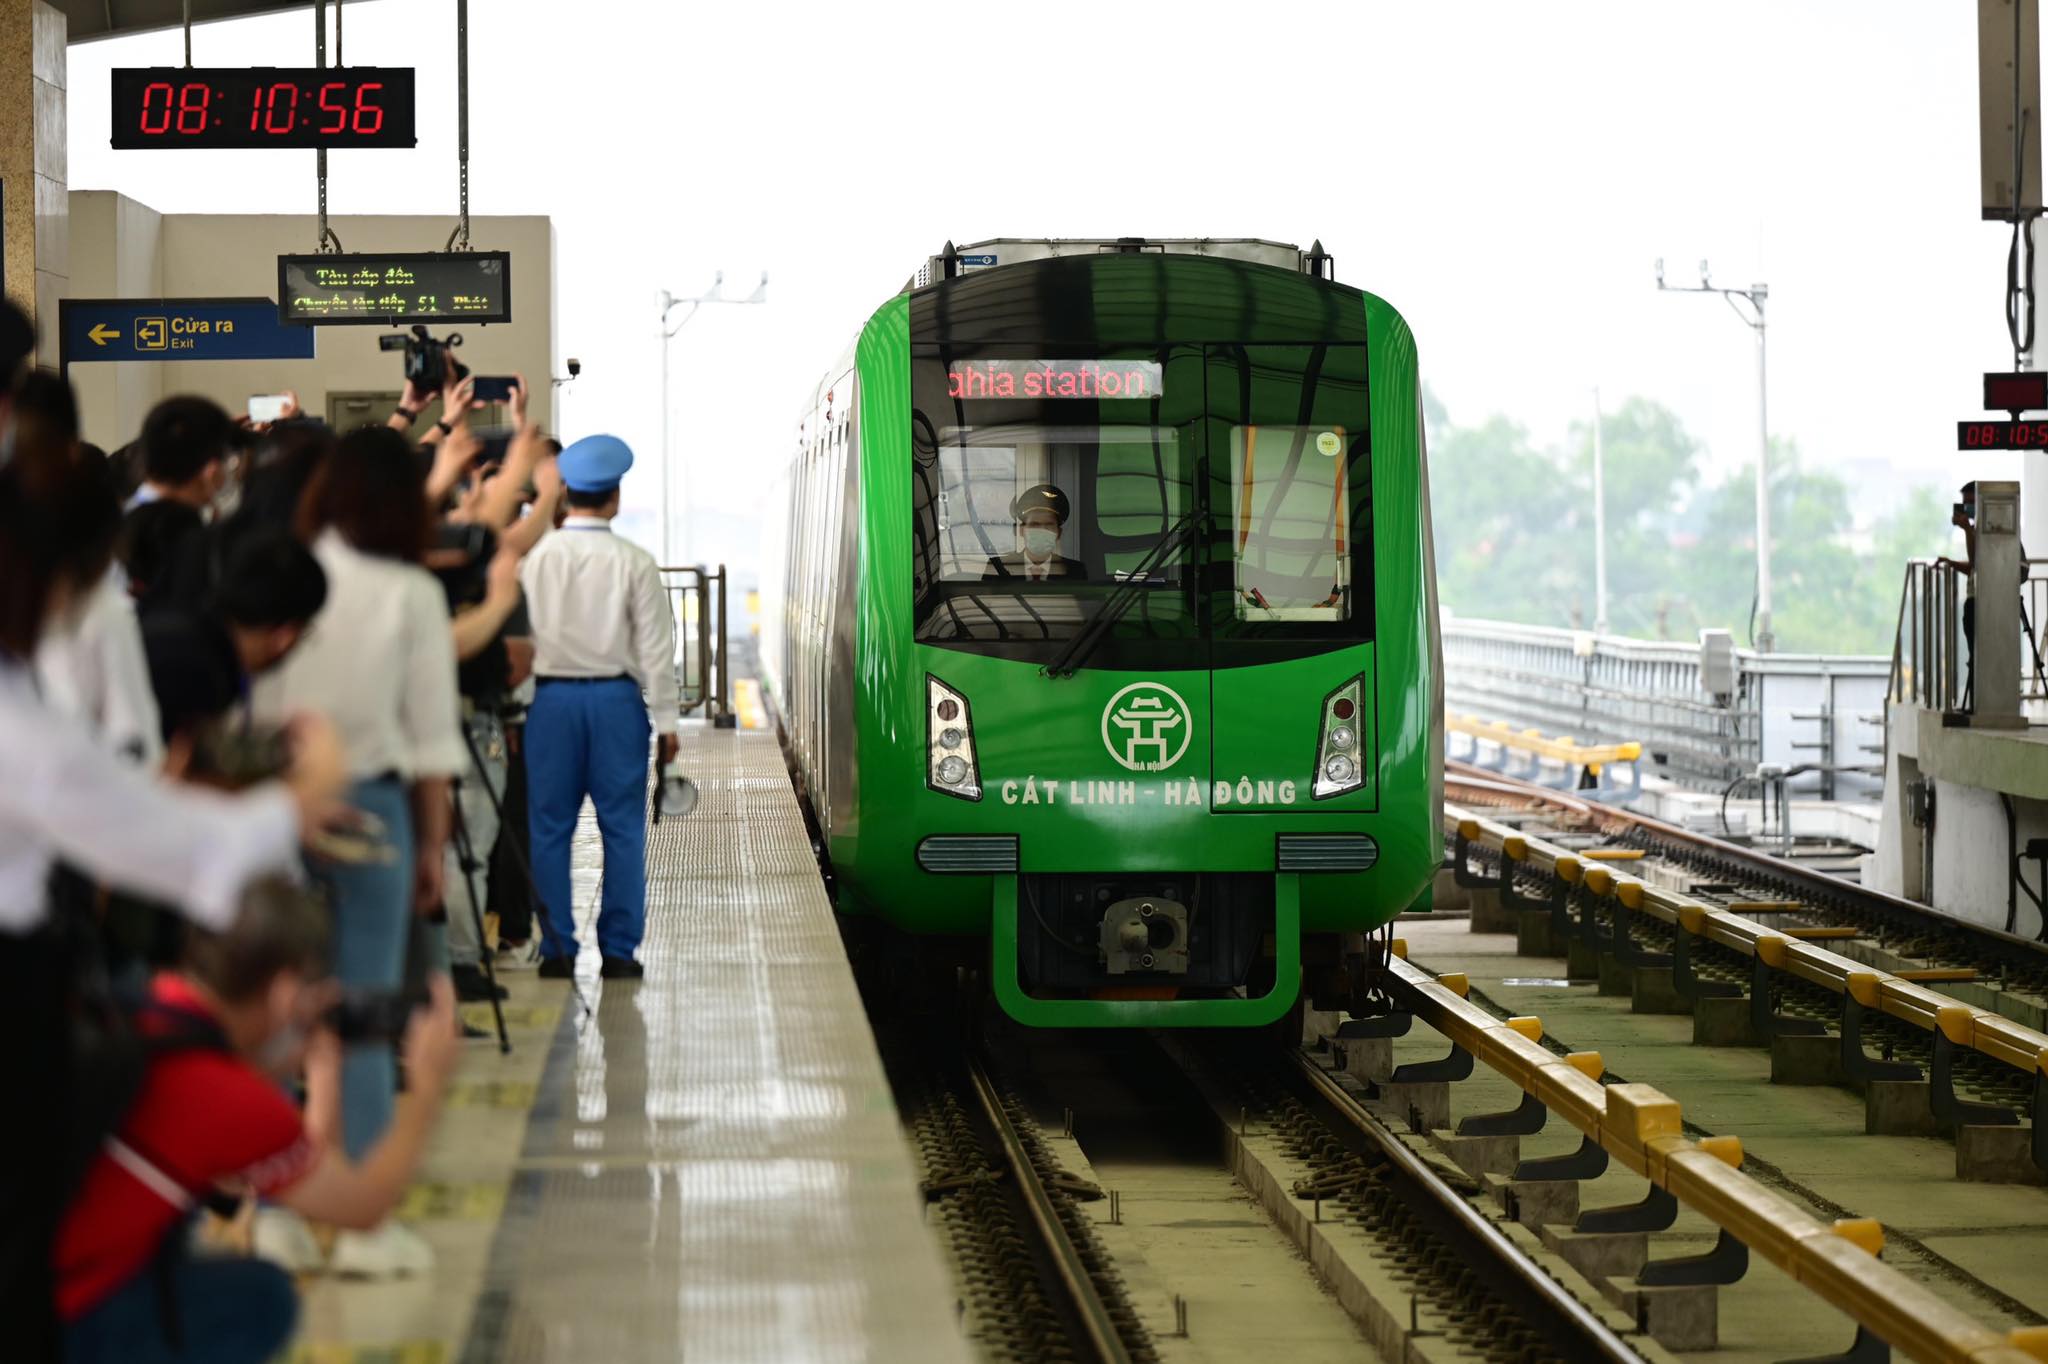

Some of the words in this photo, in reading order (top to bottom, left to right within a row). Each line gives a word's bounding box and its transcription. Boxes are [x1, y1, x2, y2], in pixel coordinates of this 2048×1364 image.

[316, 269, 348, 285] Tàu
[418, 295, 437, 312] 51
[171, 317, 210, 333] Cửa
[215, 320, 234, 333] ra
[171, 338, 194, 349] Exit
[1023, 366, 1144, 397] station
[1001, 776, 1059, 804] CÁT
[1070, 781, 1136, 804] LINH
[1164, 777, 1202, 805] HÀ
[1214, 776, 1297, 804] ĐÔNG
